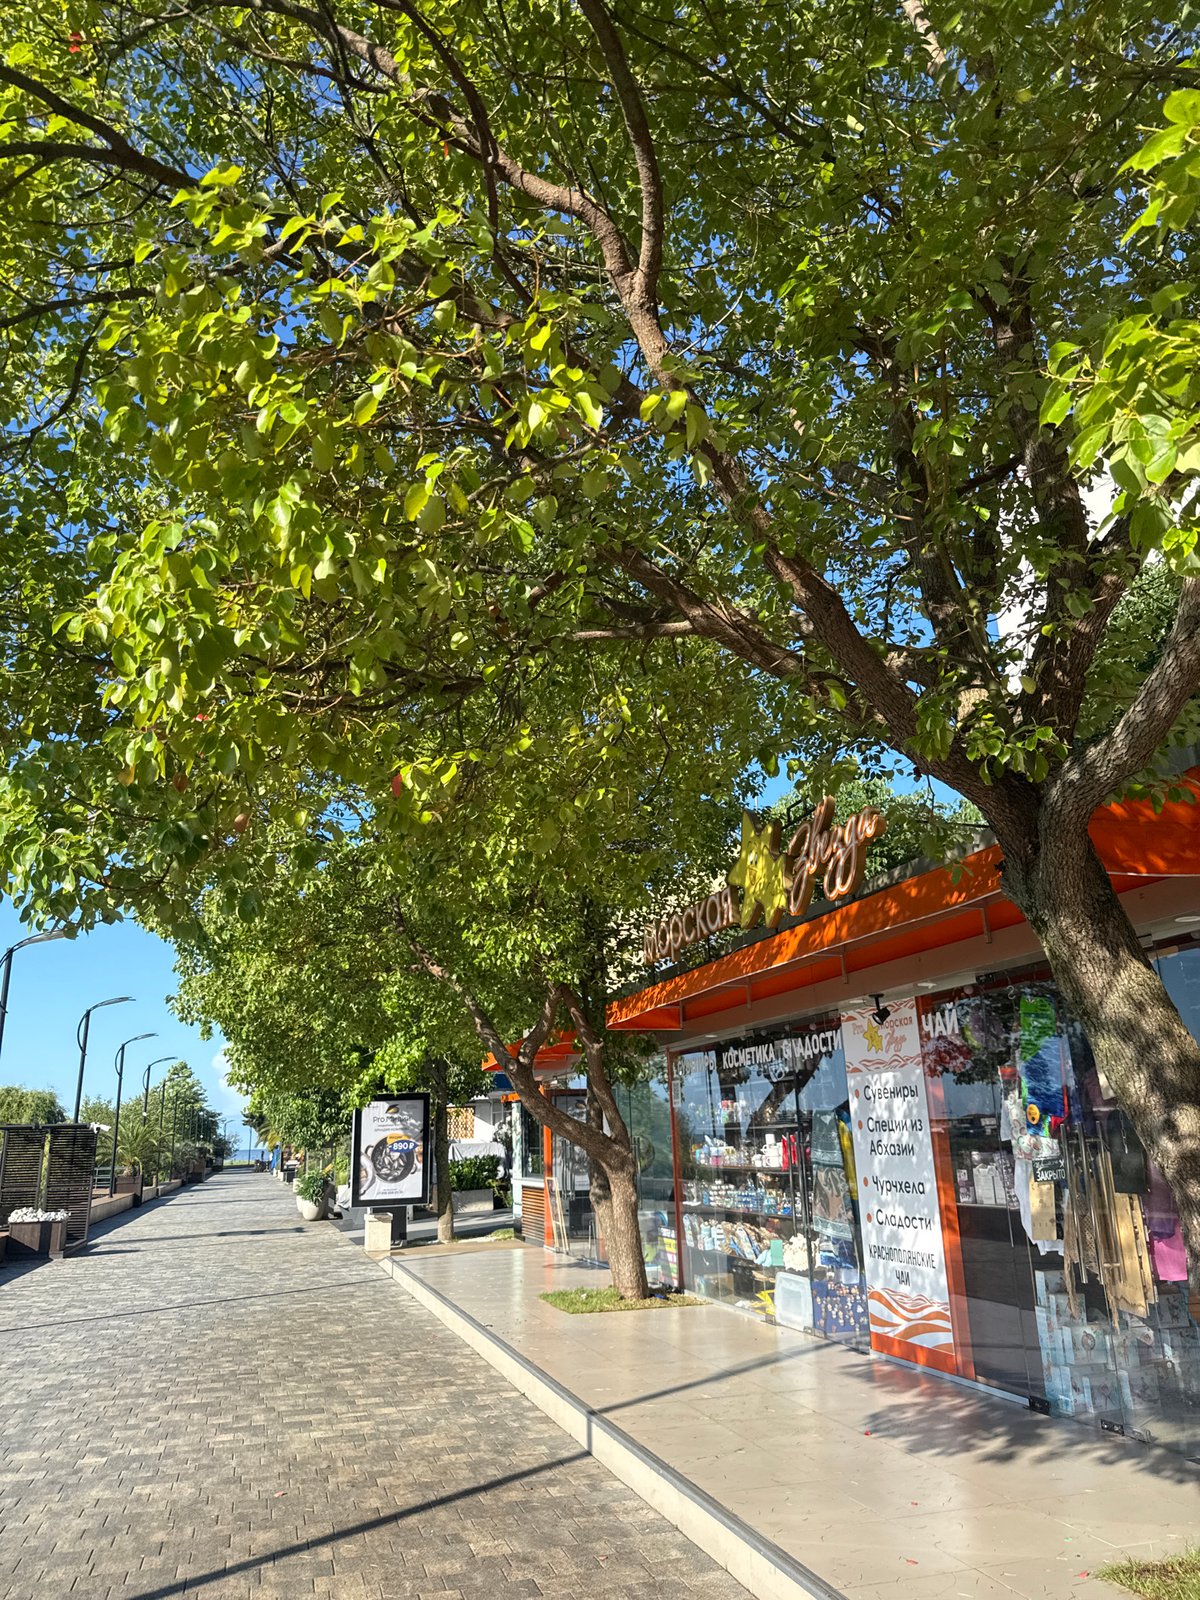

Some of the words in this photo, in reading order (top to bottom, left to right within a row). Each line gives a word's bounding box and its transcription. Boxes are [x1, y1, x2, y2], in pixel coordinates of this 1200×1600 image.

[786, 795, 881, 916] Звезда
[921, 1001, 959, 1039] ЧАЙ
[722, 1043, 775, 1070] КОСМЕТИКА
[863, 1084, 919, 1101] Сувениры
[866, 1116, 908, 1133] Специи
[911, 1118, 923, 1132] из
[869, 1139, 915, 1156] Абхазии
[872, 1175, 926, 1196] Чурчхела
[1036, 1168, 1066, 1182] ЗАКРЫТО
[875, 1208, 932, 1231] Сладости
[868, 1243, 936, 1269] КРАСНОПОЛЯНСКИЕ
[895, 1269, 911, 1287] ЧАИ
